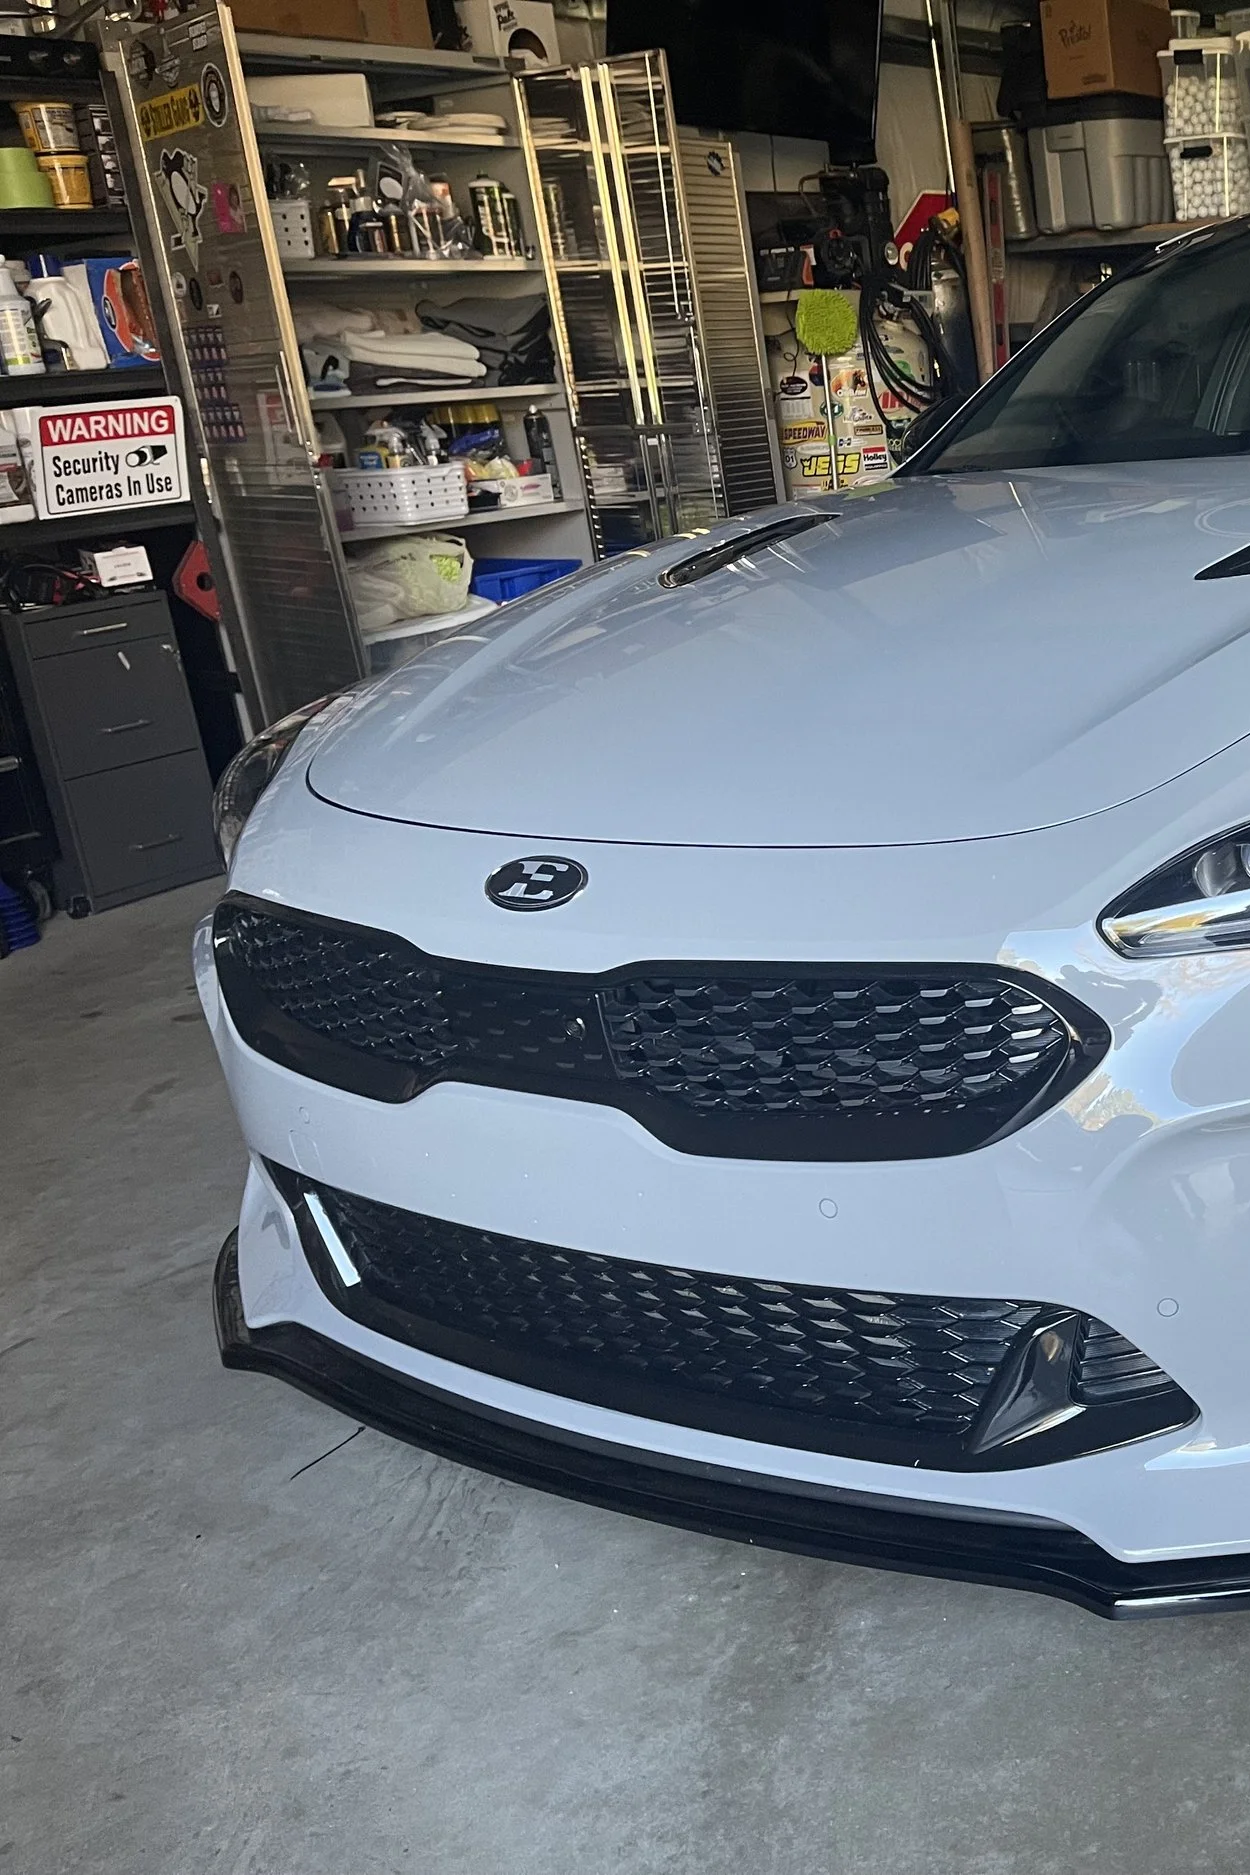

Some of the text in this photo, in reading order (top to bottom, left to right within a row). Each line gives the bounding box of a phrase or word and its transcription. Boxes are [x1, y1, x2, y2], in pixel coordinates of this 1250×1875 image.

[47, 410, 169, 443] WARNING
[784, 426, 826, 440] SPEEDWAY
[53, 451, 119, 477] Security
[863, 453, 887, 462] Holley
[56, 473, 172, 506] Cameras In Use
